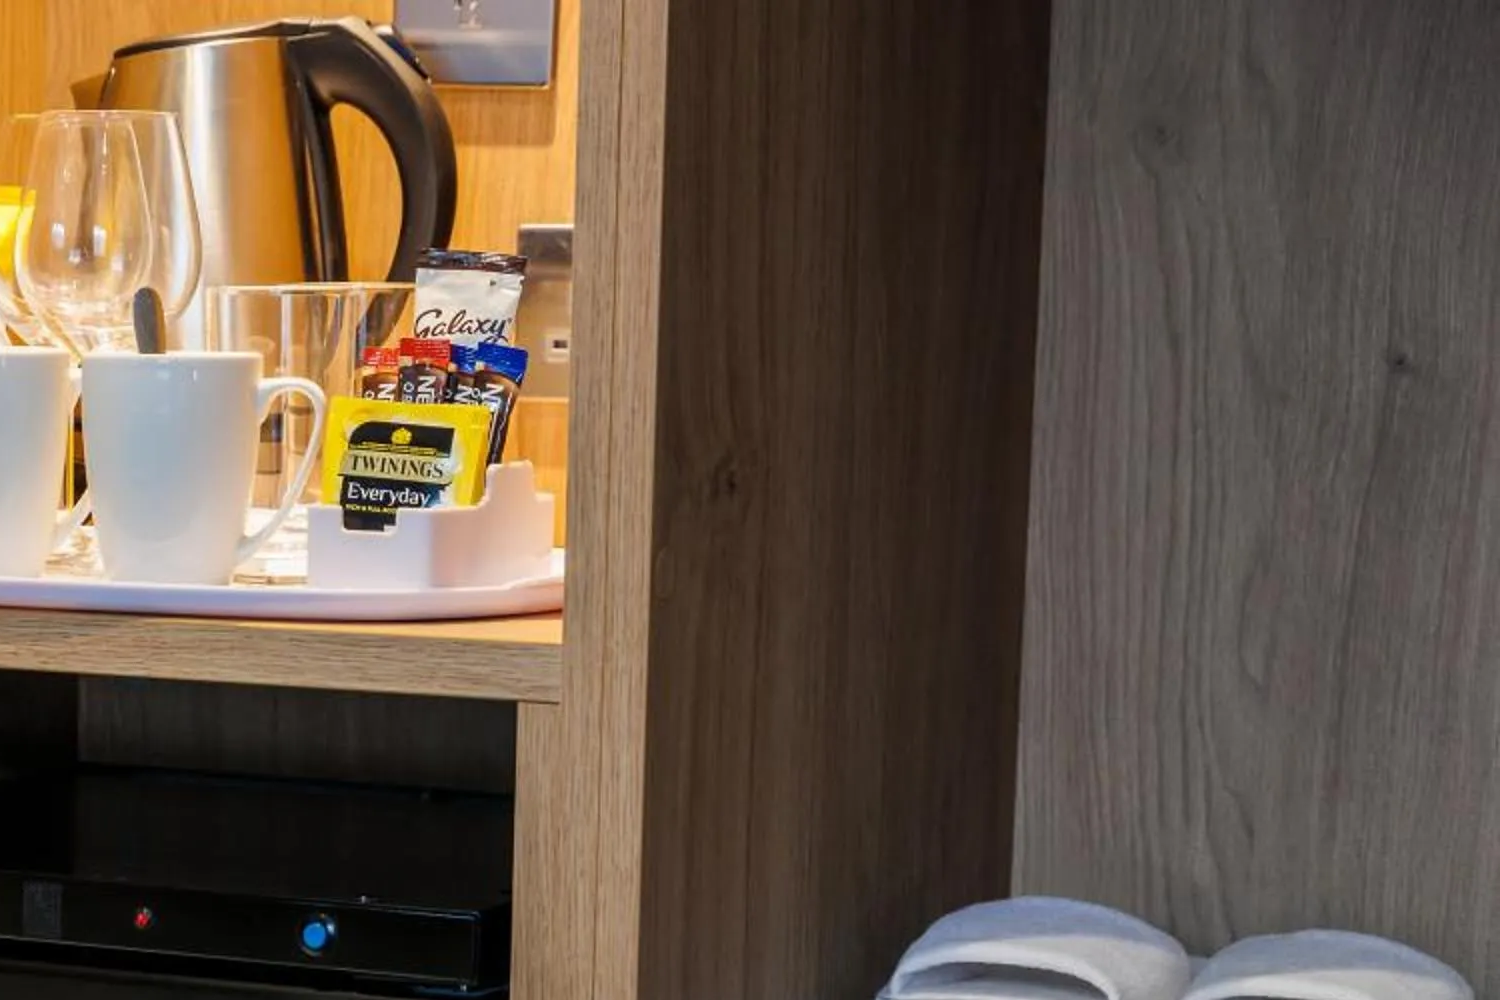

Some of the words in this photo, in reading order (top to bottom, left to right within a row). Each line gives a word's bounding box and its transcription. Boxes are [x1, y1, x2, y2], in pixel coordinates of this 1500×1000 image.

[414, 308, 507, 341] Galaxy
[350, 455, 444, 479] TWININGS
[347, 480, 432, 508] Everyday
